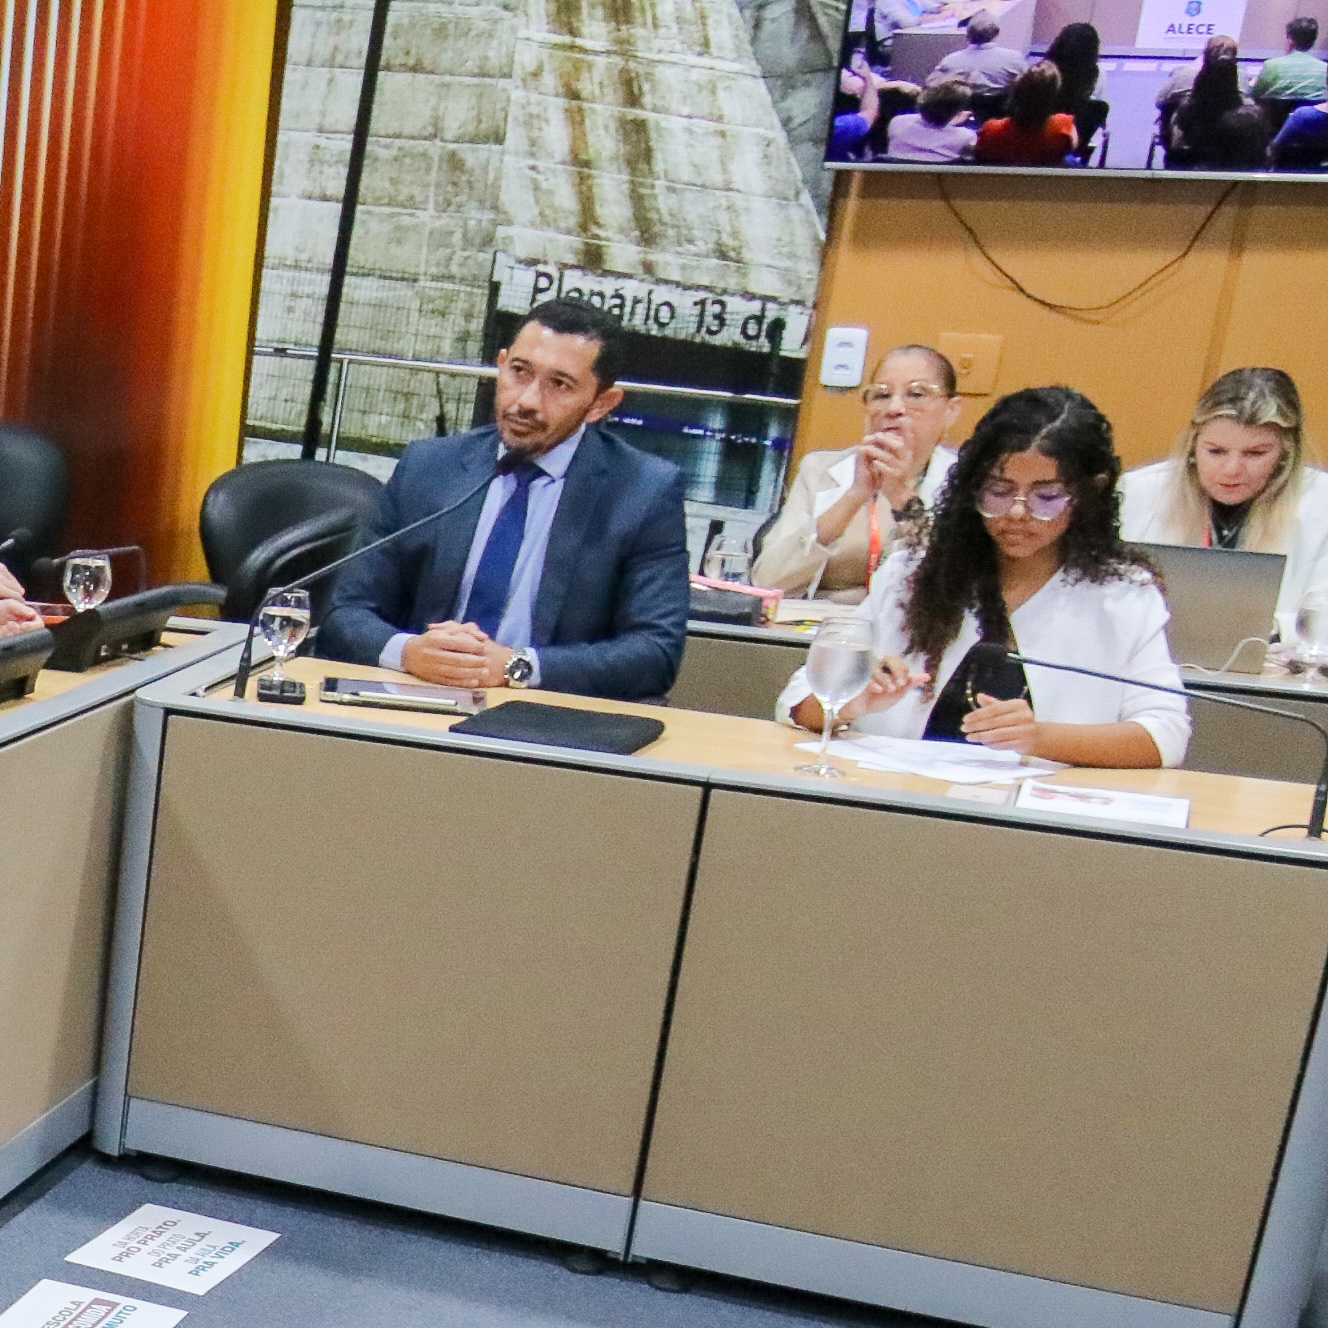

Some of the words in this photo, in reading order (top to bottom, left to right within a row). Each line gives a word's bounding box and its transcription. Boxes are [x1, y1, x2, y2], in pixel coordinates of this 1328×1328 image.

[1165, 23, 1215, 35] ALECE
[693, 297, 727, 336] 13
[111, 1246, 142, 1263] PRO
[136, 1219, 182, 1246] PRATO.
[151, 1252, 182, 1269] PRA
[176, 1230, 212, 1253] AULA.
[187, 1260, 219, 1277] PRA
[210, 1239, 248, 1260] VIDA.
